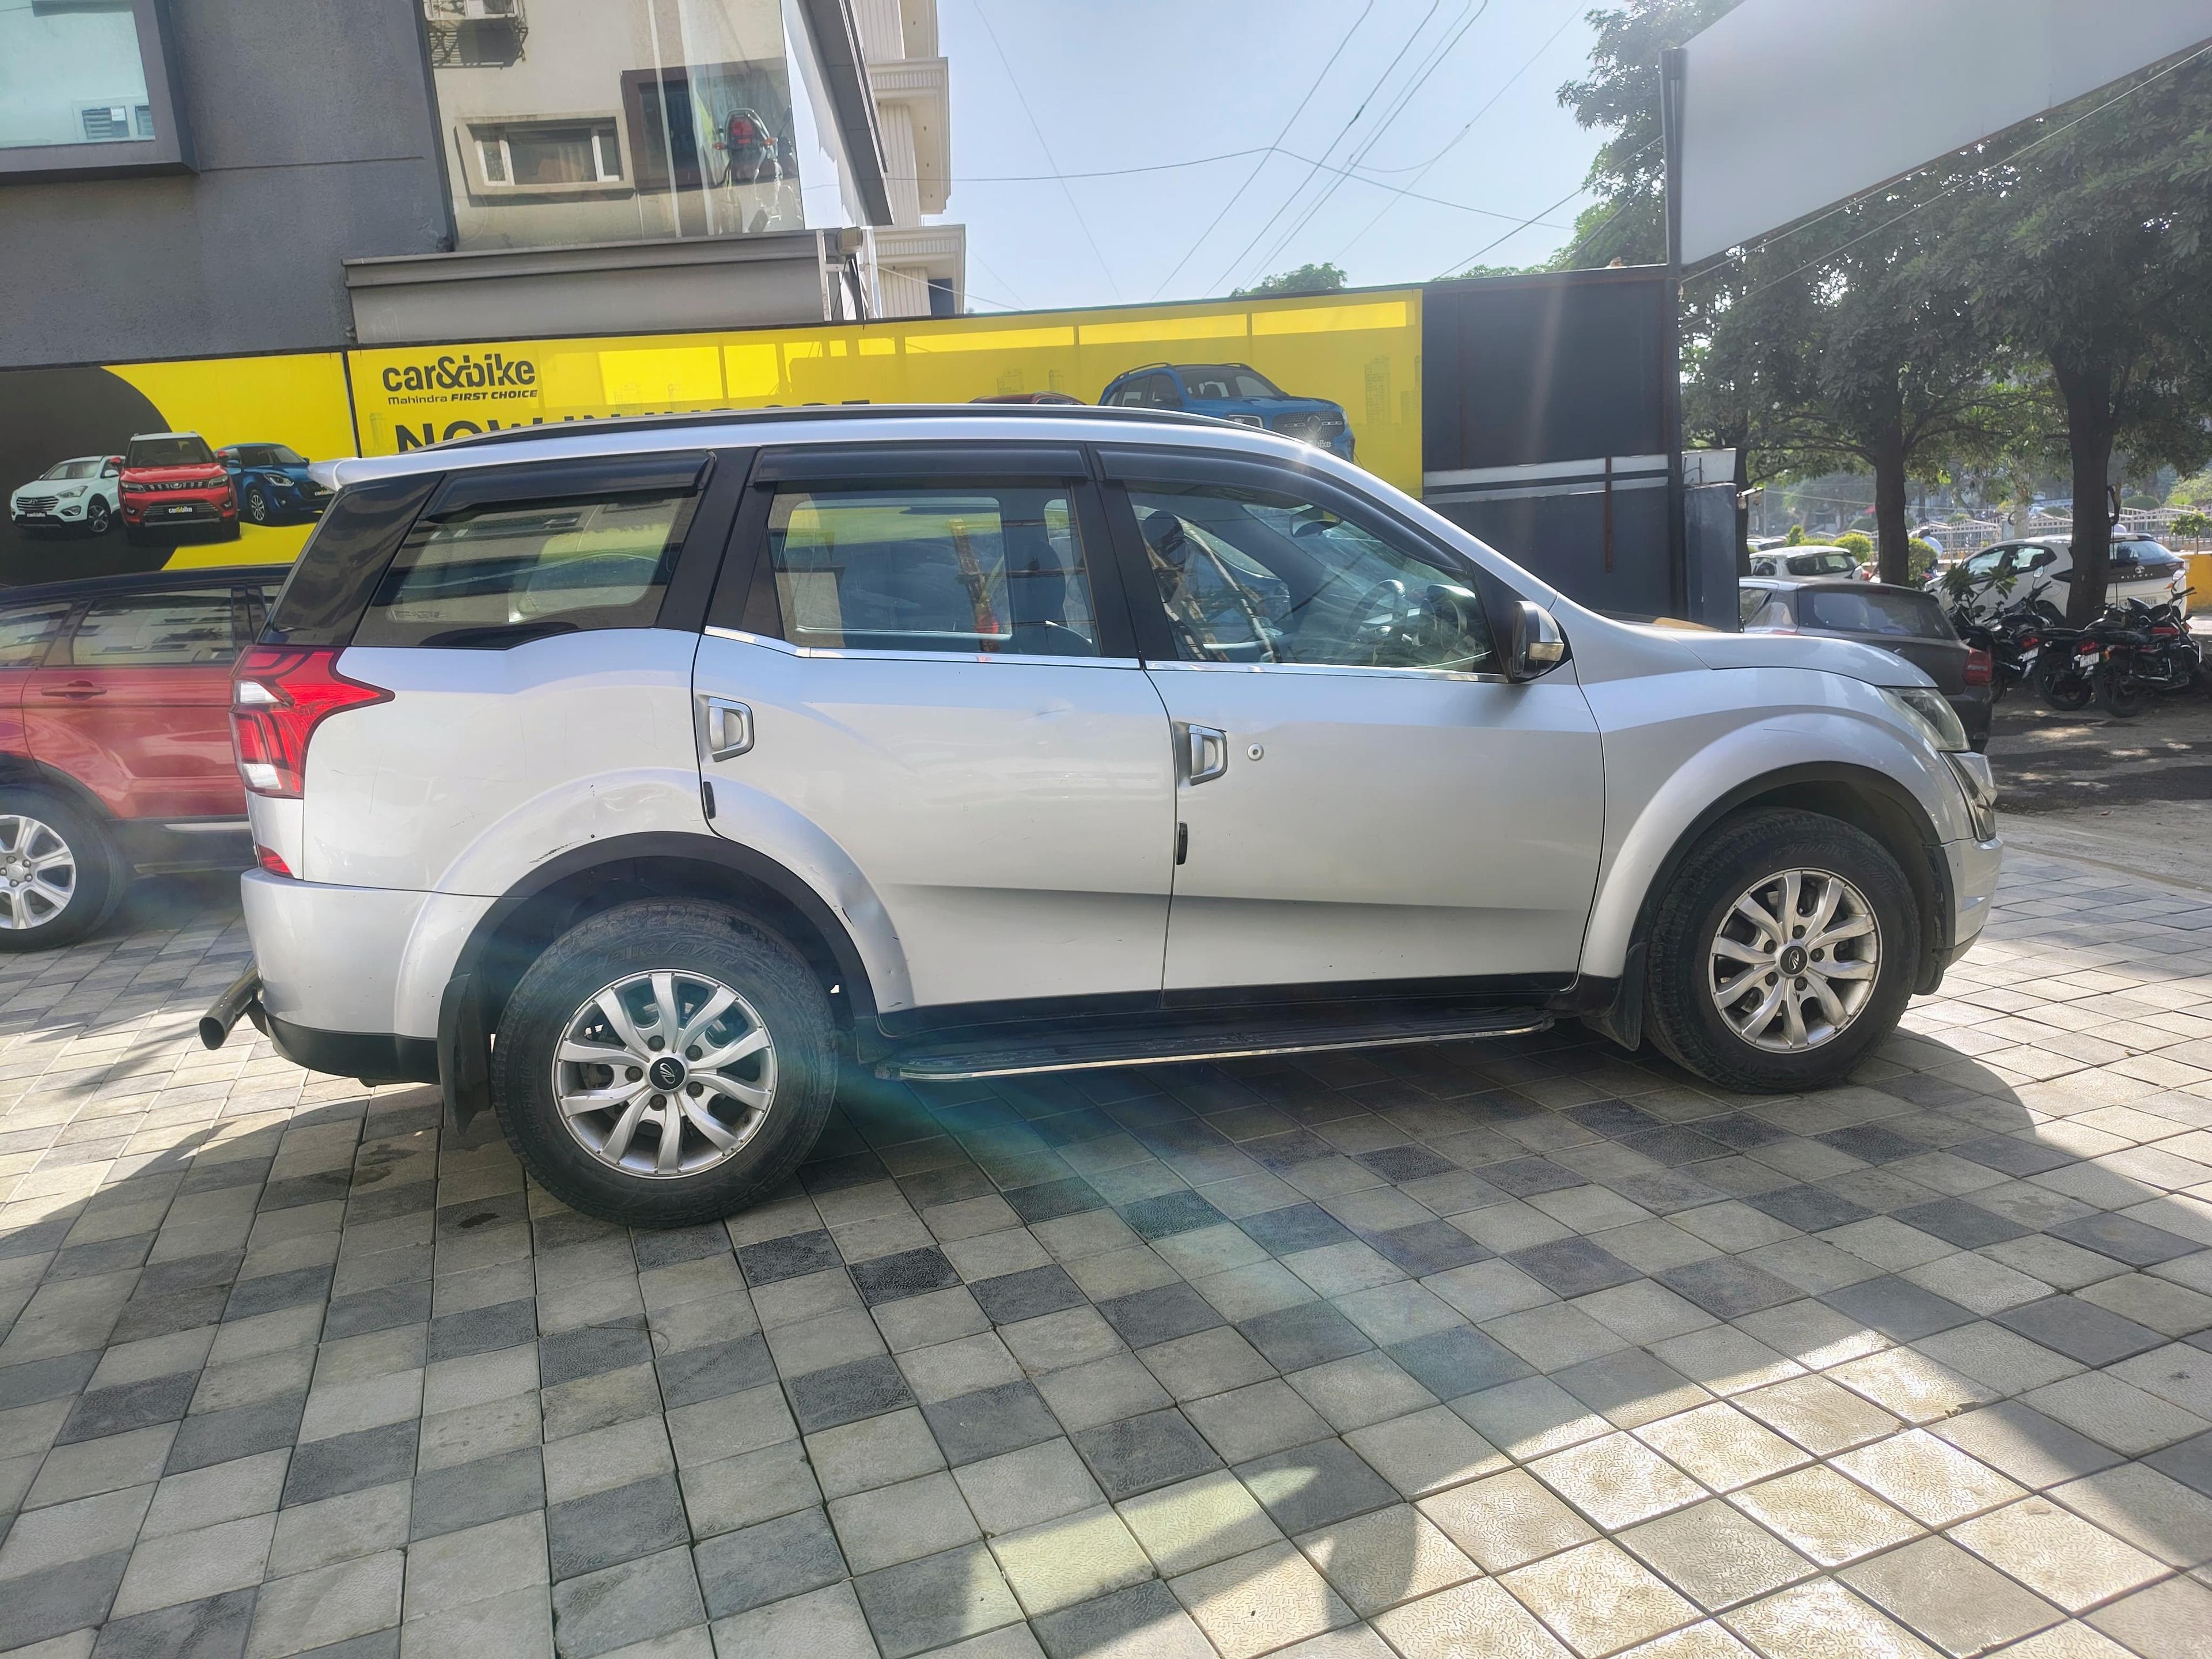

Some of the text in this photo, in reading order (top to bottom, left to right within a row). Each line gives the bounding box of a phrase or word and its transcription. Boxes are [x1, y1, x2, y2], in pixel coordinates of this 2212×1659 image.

[382, 353, 535, 392] car&bike
[388, 389, 538, 406] Mahindra FIRST CHOICE
